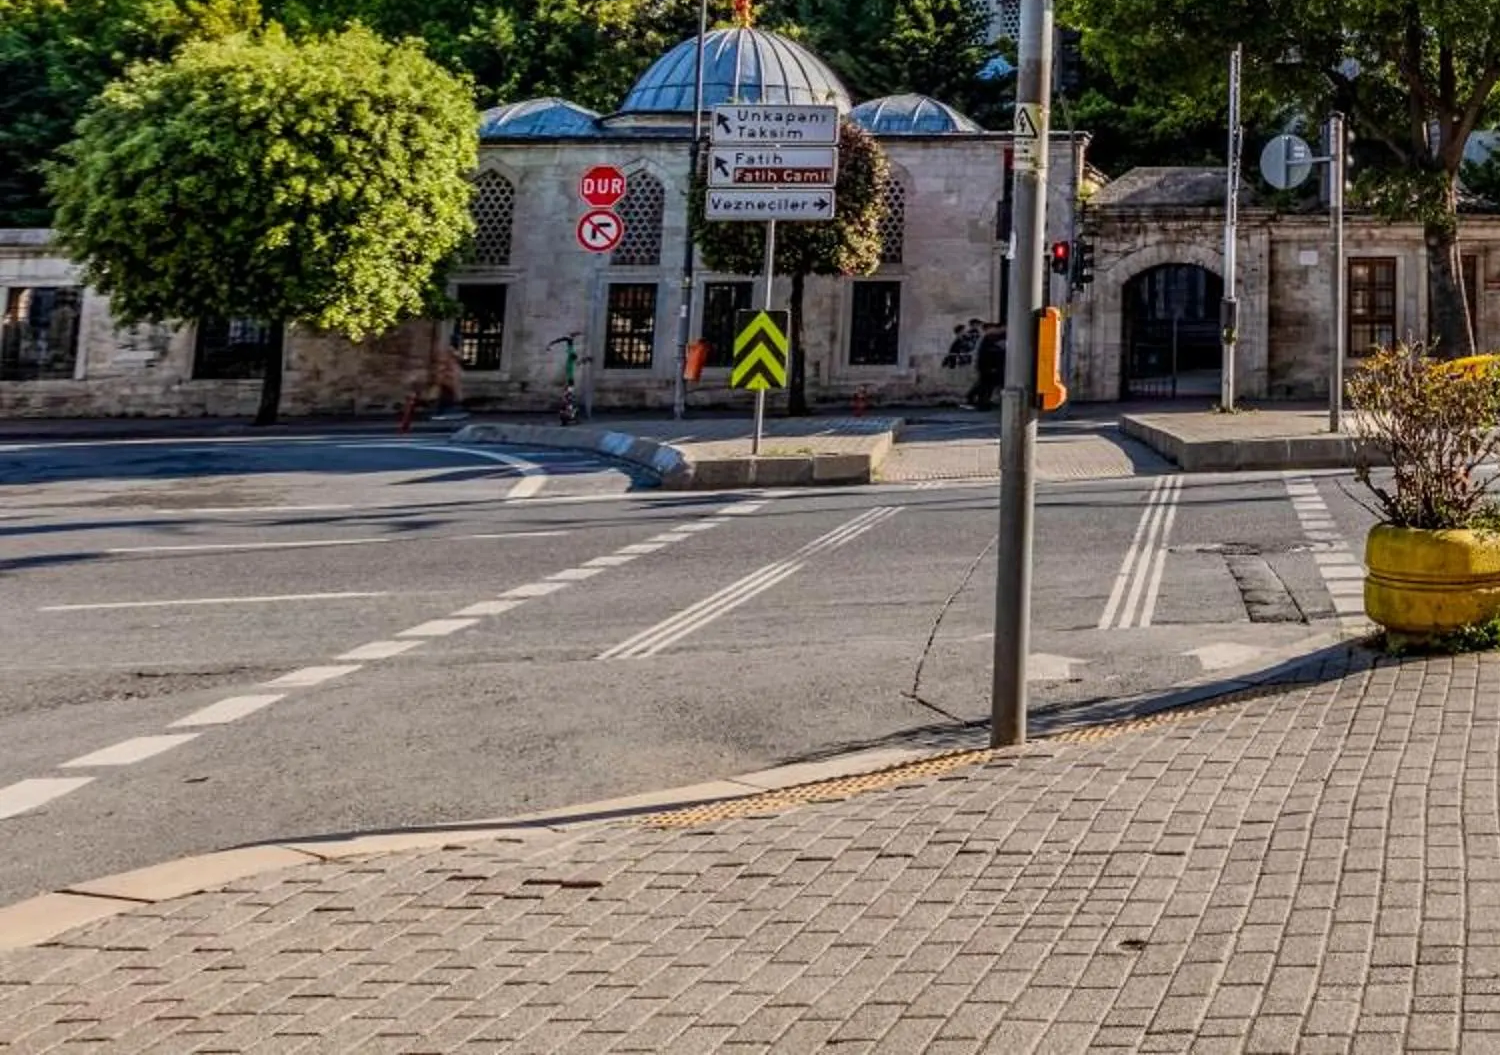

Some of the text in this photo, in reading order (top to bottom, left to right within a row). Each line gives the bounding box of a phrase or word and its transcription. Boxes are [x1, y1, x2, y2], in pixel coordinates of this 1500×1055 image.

[738, 126, 804, 139] Taksim
[735, 152, 783, 165] Fatih
[735, 169, 777, 182] Fatih
[583, 178, 623, 194] DUR
